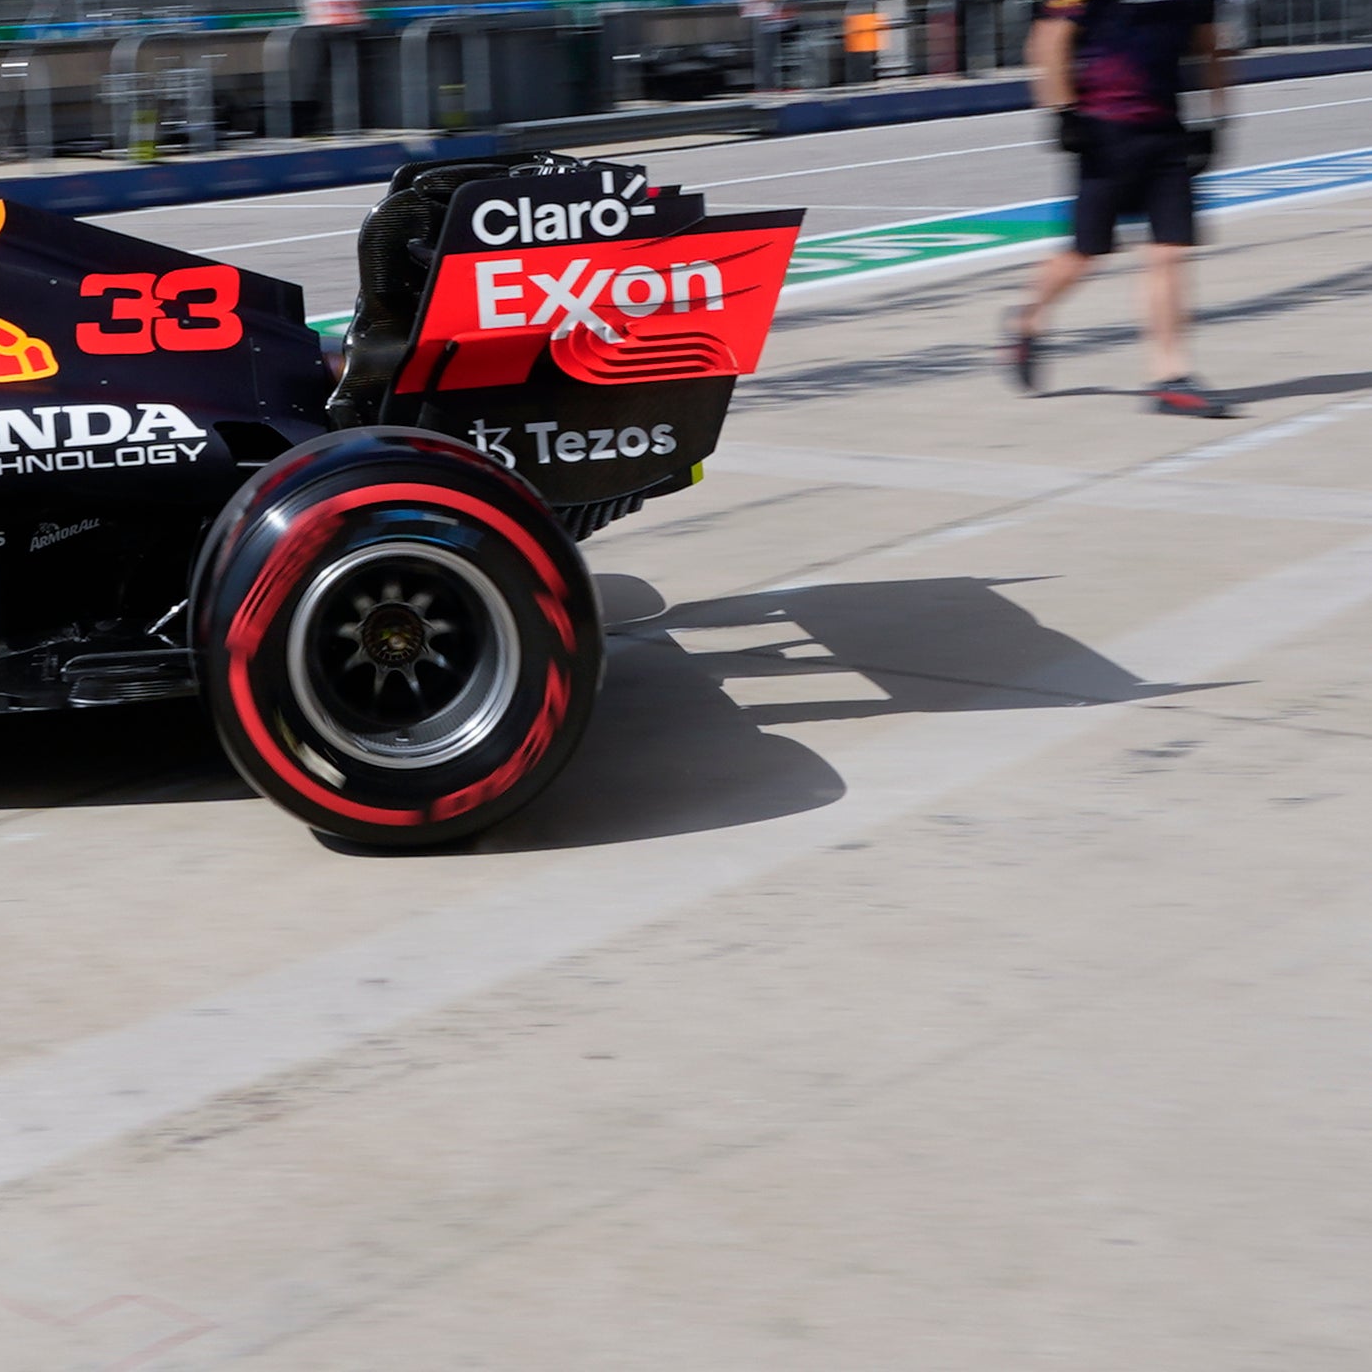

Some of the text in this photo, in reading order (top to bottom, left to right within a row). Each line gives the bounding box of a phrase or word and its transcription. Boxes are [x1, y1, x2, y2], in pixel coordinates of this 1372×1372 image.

[472, 196, 630, 246] Claro
[76, 265, 244, 355] 33
[475, 258, 725, 344] Exxon
[524, 421, 677, 465] Tezos
